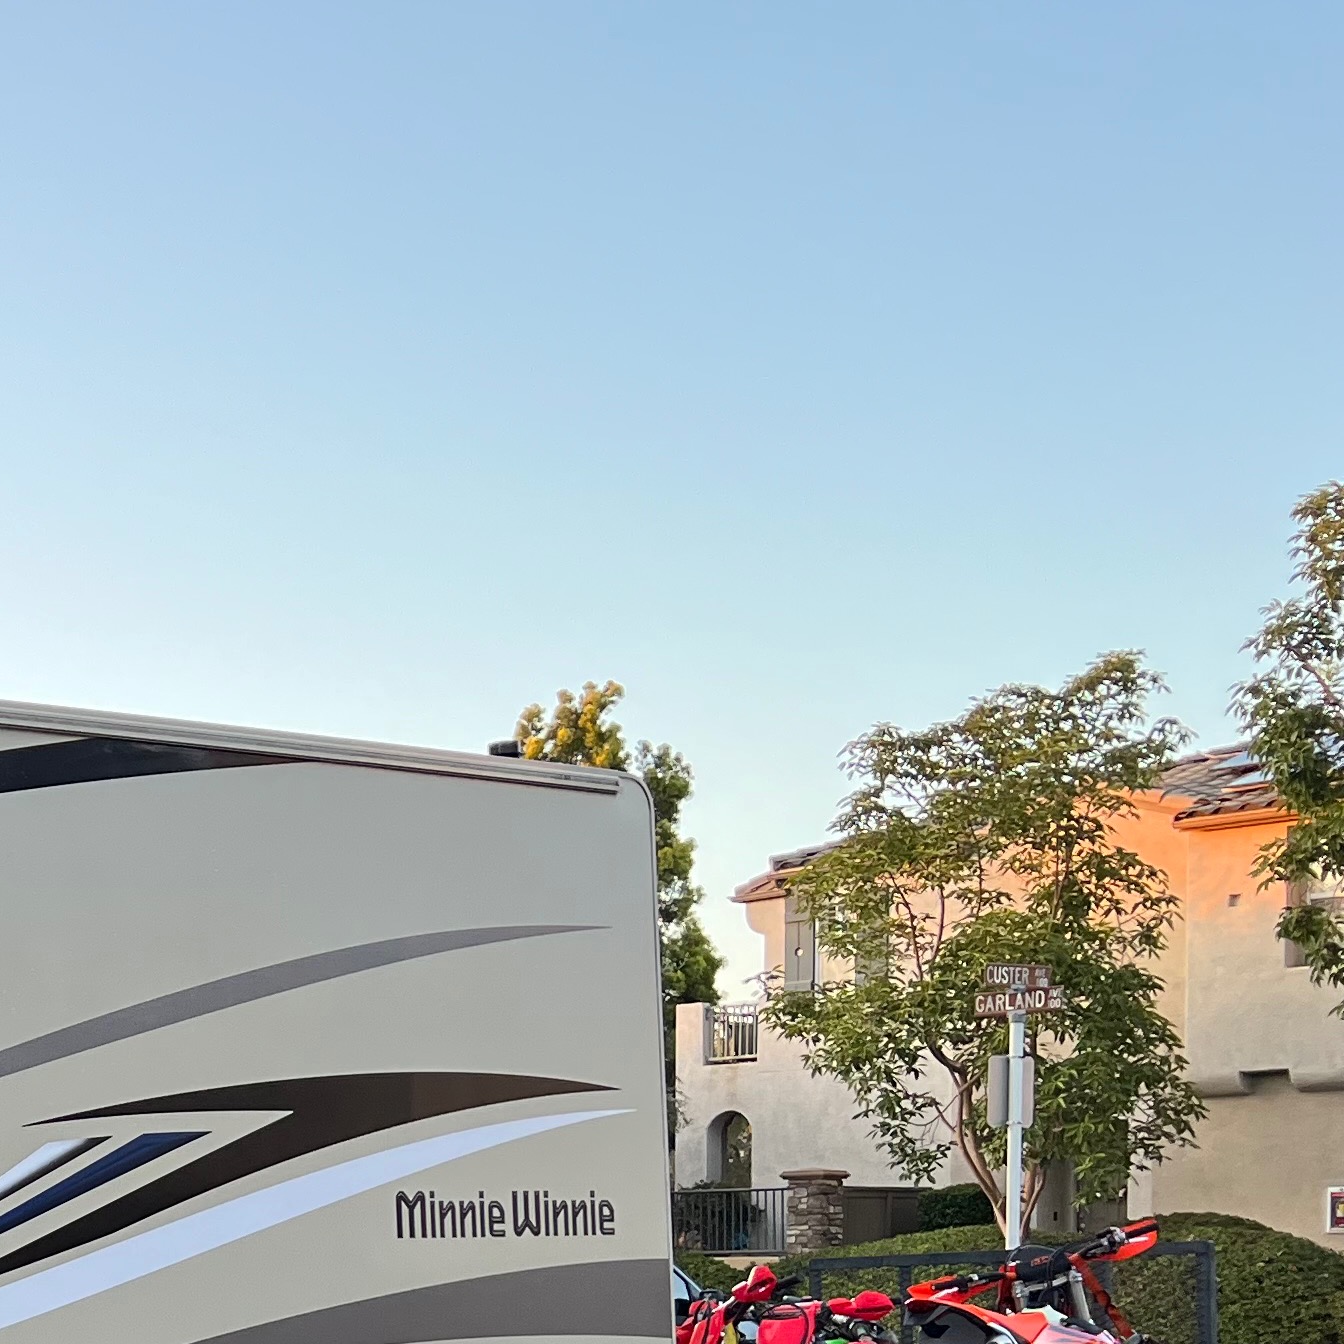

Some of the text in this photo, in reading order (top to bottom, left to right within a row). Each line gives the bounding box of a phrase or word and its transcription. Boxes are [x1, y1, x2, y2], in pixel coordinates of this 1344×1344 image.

[986, 965, 1030, 985] CUSTER
[975, 987, 1062, 1013] GARLAND AVE
[395, 1190, 616, 1239] Minnie Winnie
